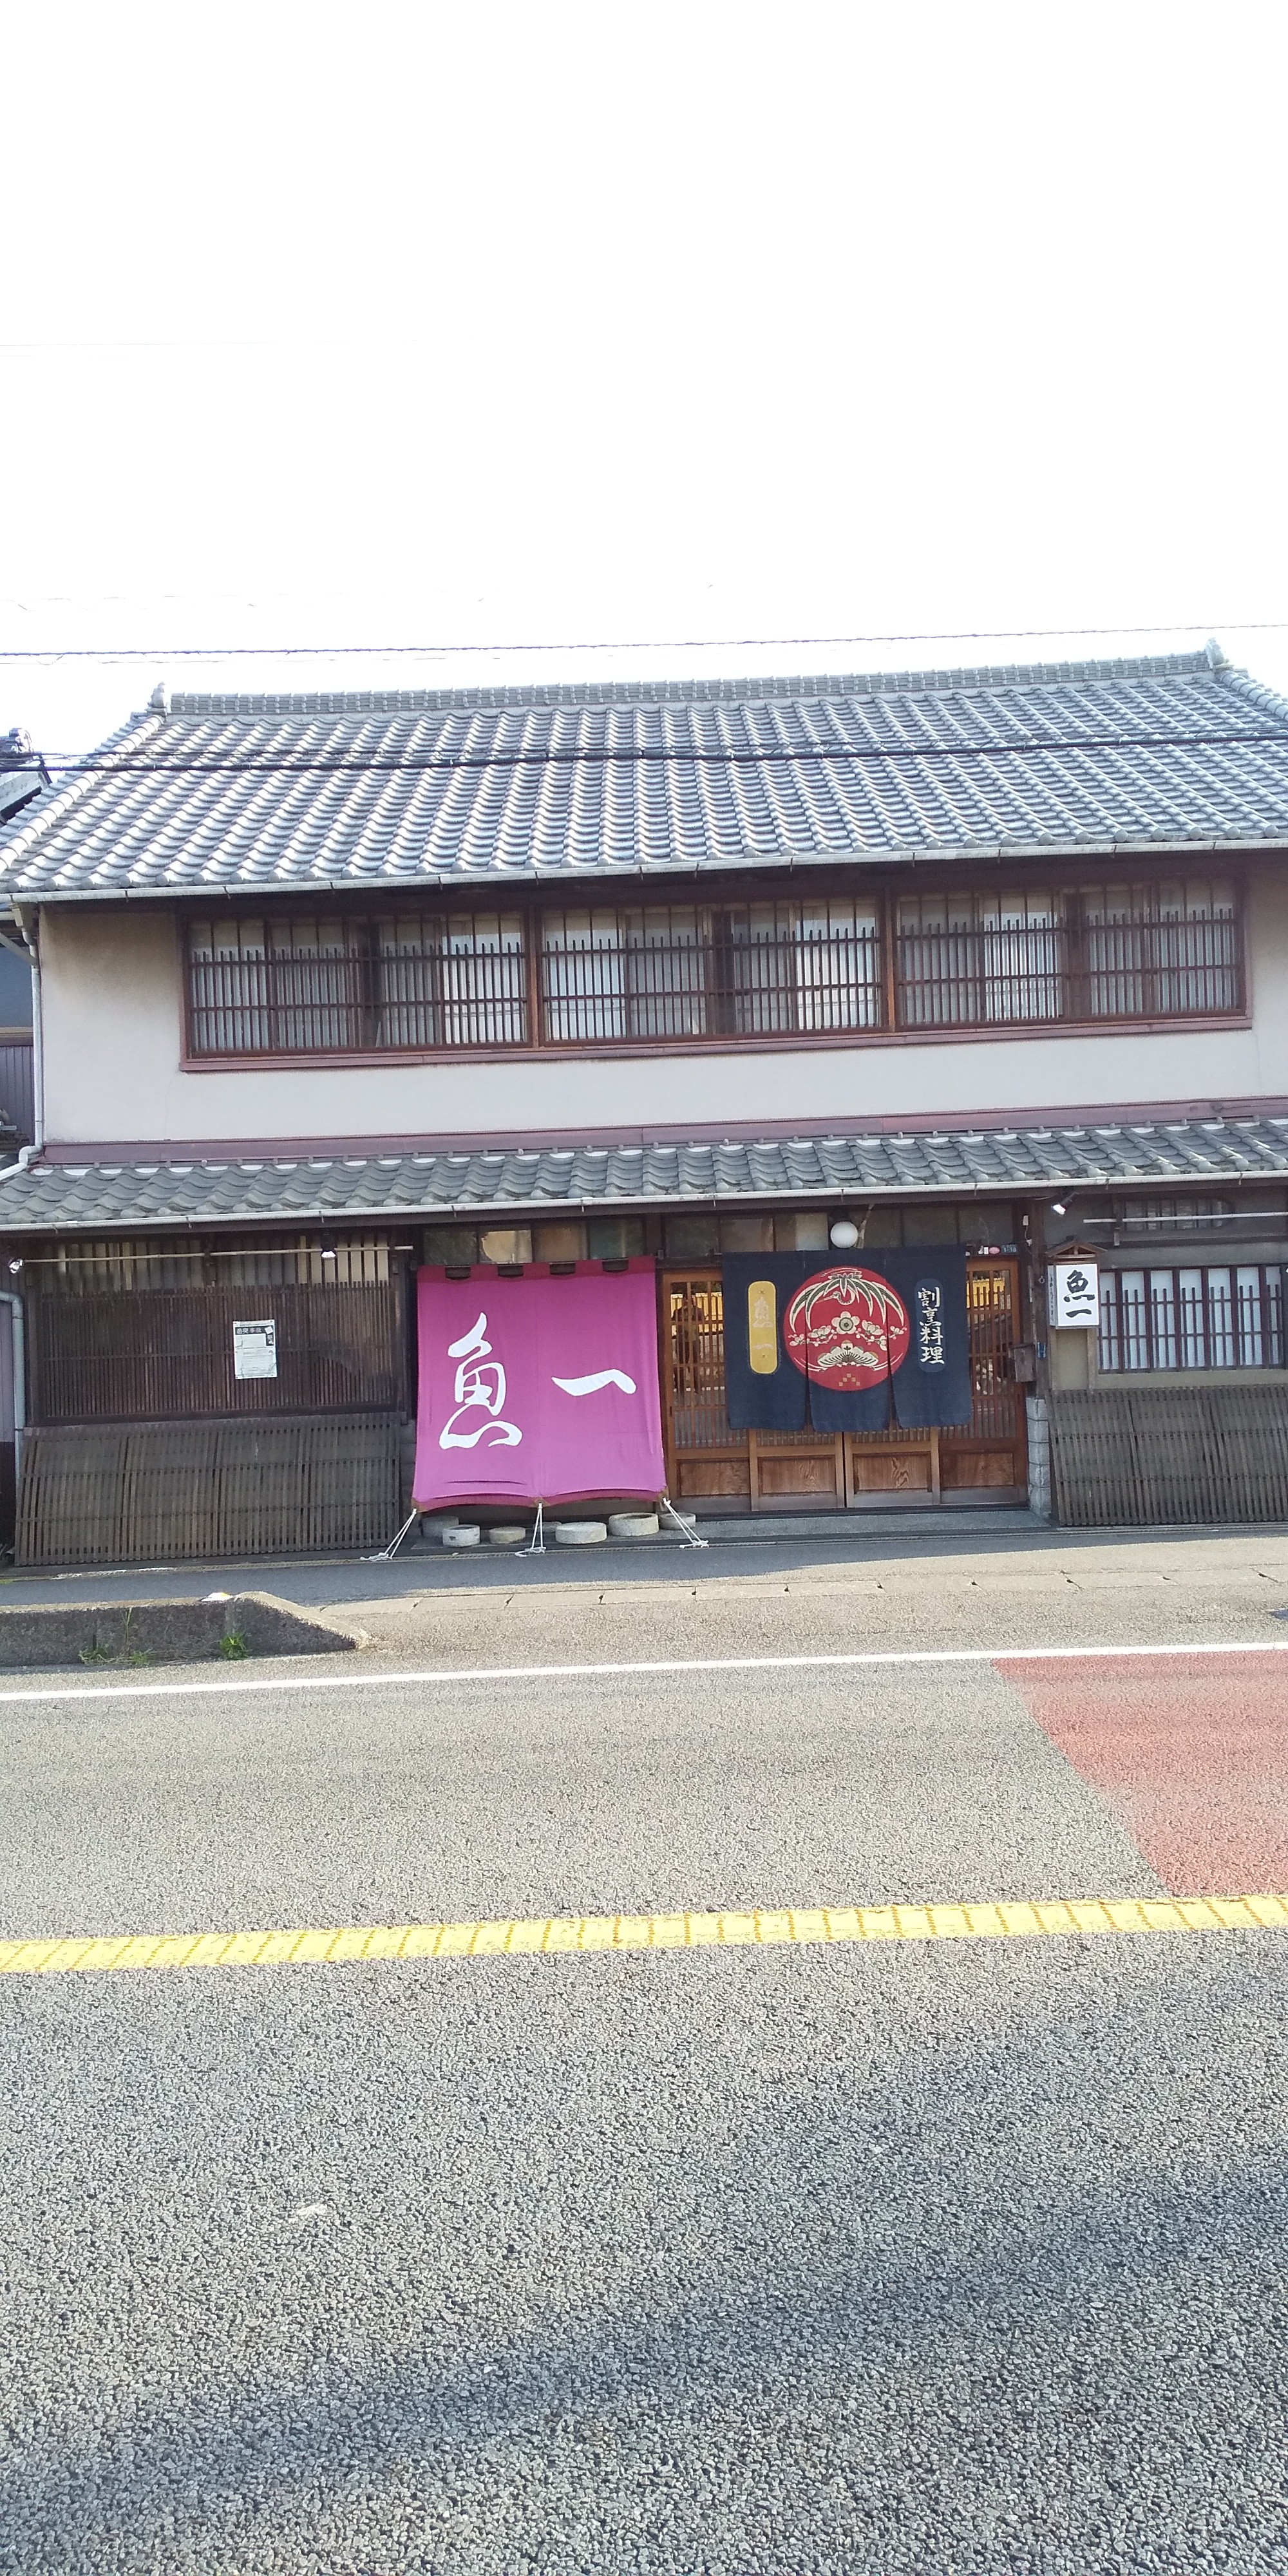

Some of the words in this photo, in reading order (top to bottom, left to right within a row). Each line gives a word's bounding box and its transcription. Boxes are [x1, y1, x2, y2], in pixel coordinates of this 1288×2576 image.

[753, 1295, 774, 1350] 魚一
[918, 1287, 945, 1364] 割烹料理
[1063, 1269, 1095, 1318] 魚一
[439, 1312, 637, 1450] 魚一
